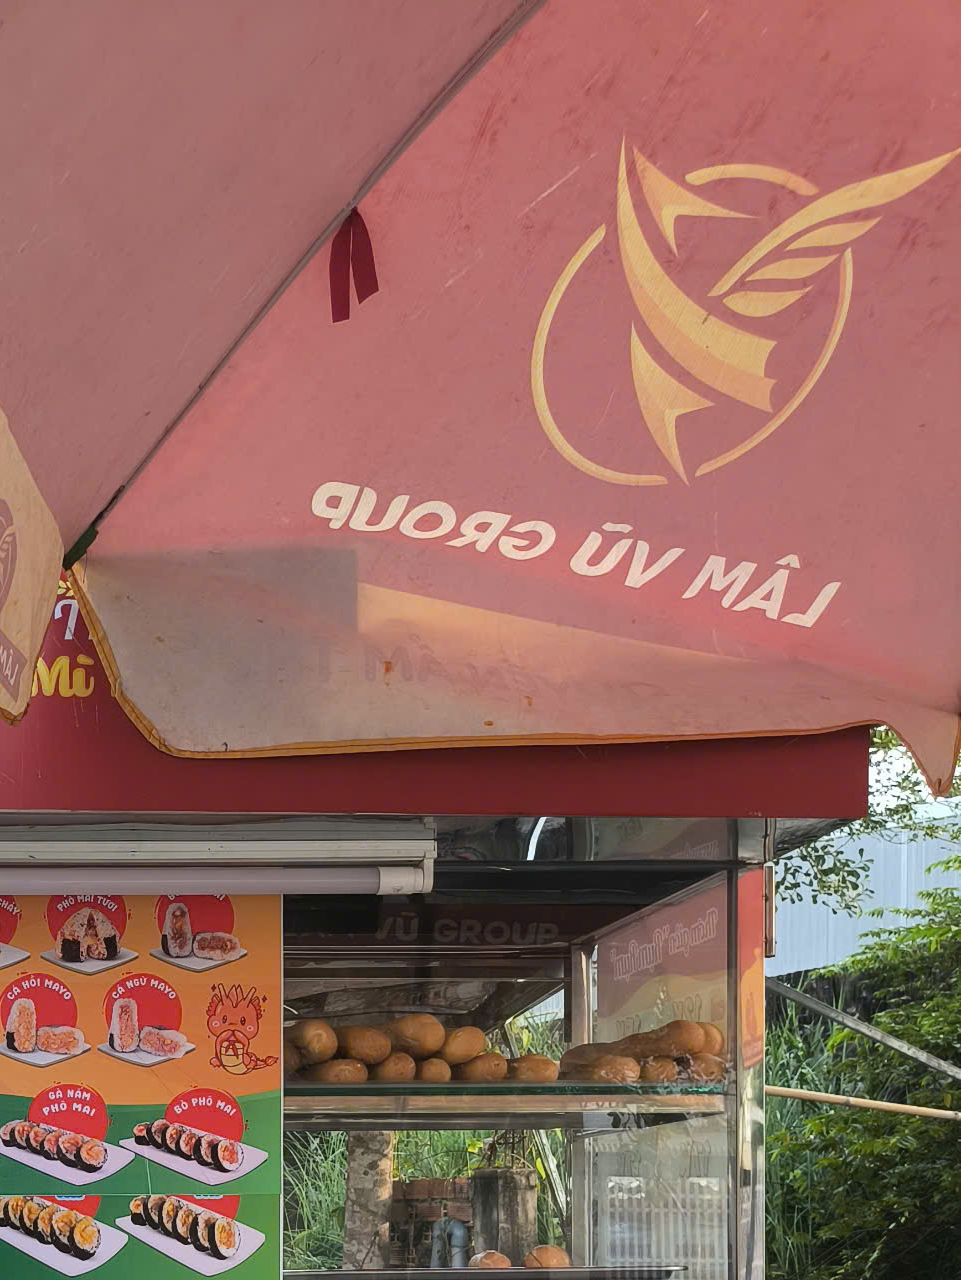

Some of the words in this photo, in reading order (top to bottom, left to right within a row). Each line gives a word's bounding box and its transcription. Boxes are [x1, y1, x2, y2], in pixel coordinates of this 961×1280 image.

[57, 896, 76, 912] PHÔ
[434, 918, 559, 945] GROUP
[7, 985, 21, 1000] CÁ
[22, 975, 41, 990] HỒI
[44, 979, 71, 1000] MAYO
[111, 985, 125, 999] CÁ
[126, 976, 147, 989] NGỪ
[150, 979, 176, 1000] MAYO
[49, 1088, 63, 1099] GÀ
[42, 1101, 67, 1116] PHÔ
[72, 1103, 96, 1117] MAI
[174, 1100, 188, 1114] BÒ
[191, 1096, 213, 1106] PHÔ
[216, 1100, 236, 1116] MAI
